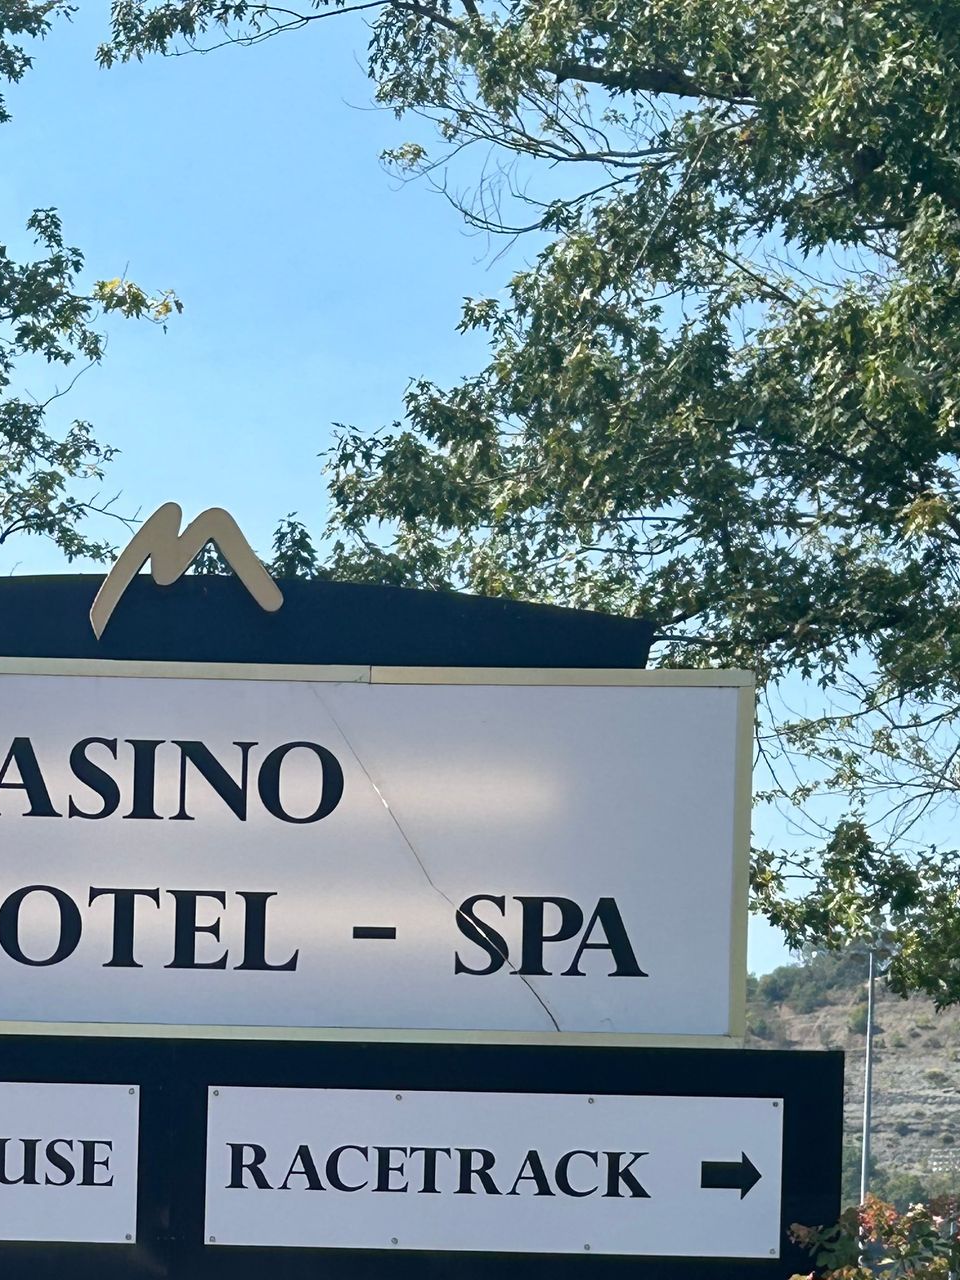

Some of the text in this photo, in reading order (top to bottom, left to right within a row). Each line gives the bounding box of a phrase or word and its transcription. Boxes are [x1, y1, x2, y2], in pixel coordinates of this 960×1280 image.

[352, 926, 397, 941] -
[454, 894, 649, 978] SPA
[224, 1142, 652, 1199] RACETRACK
